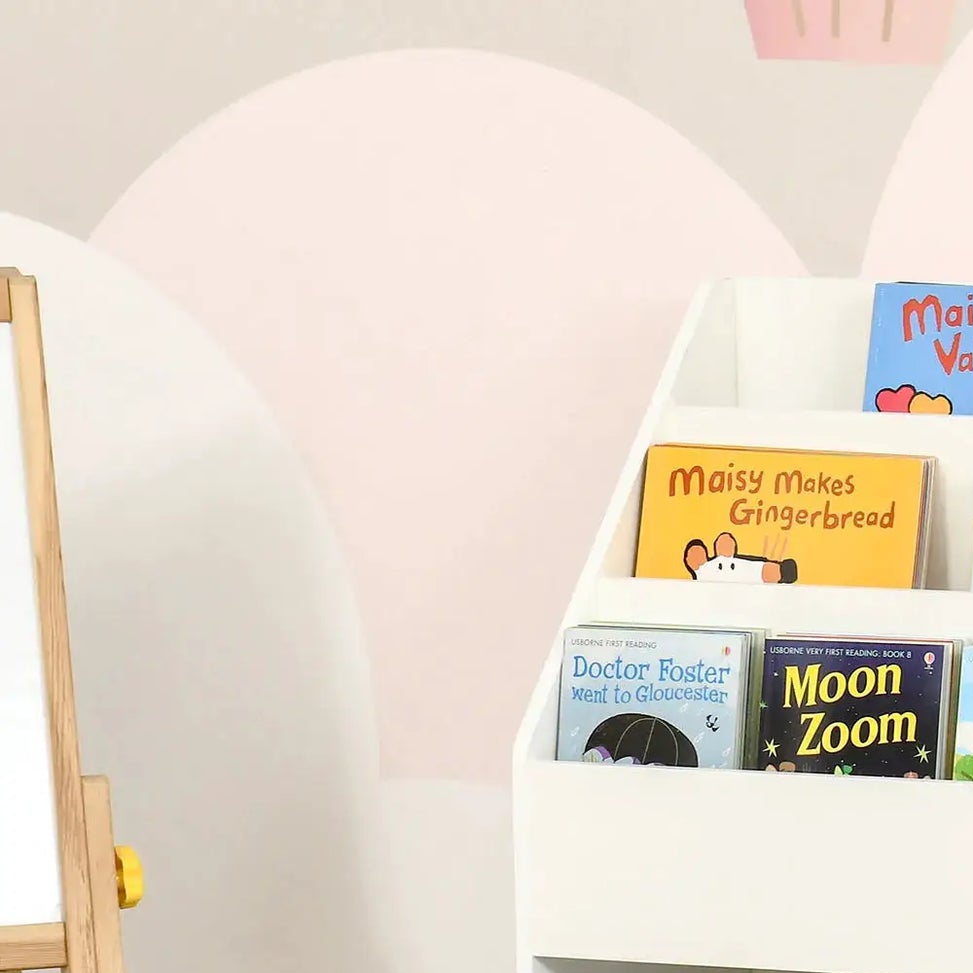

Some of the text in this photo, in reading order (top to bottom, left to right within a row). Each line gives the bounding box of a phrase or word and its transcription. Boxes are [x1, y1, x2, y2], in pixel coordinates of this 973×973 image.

[669, 462, 855, 498] Maisy Makes
[729, 498, 896, 531] Gingerbread
[571, 638, 657, 649] USBORNE FIRST READING
[770, 646, 804, 655] USBORNE
[805, 647, 823, 656] VERY
[825, 648, 844, 656] FIRST
[882, 650, 905, 659] BOOK
[573, 655, 731, 685] Doctor Foster
[571, 683, 728, 704] went to Gloucester
[782, 663, 902, 709] Moon
[796, 711, 917, 757] Zoom
